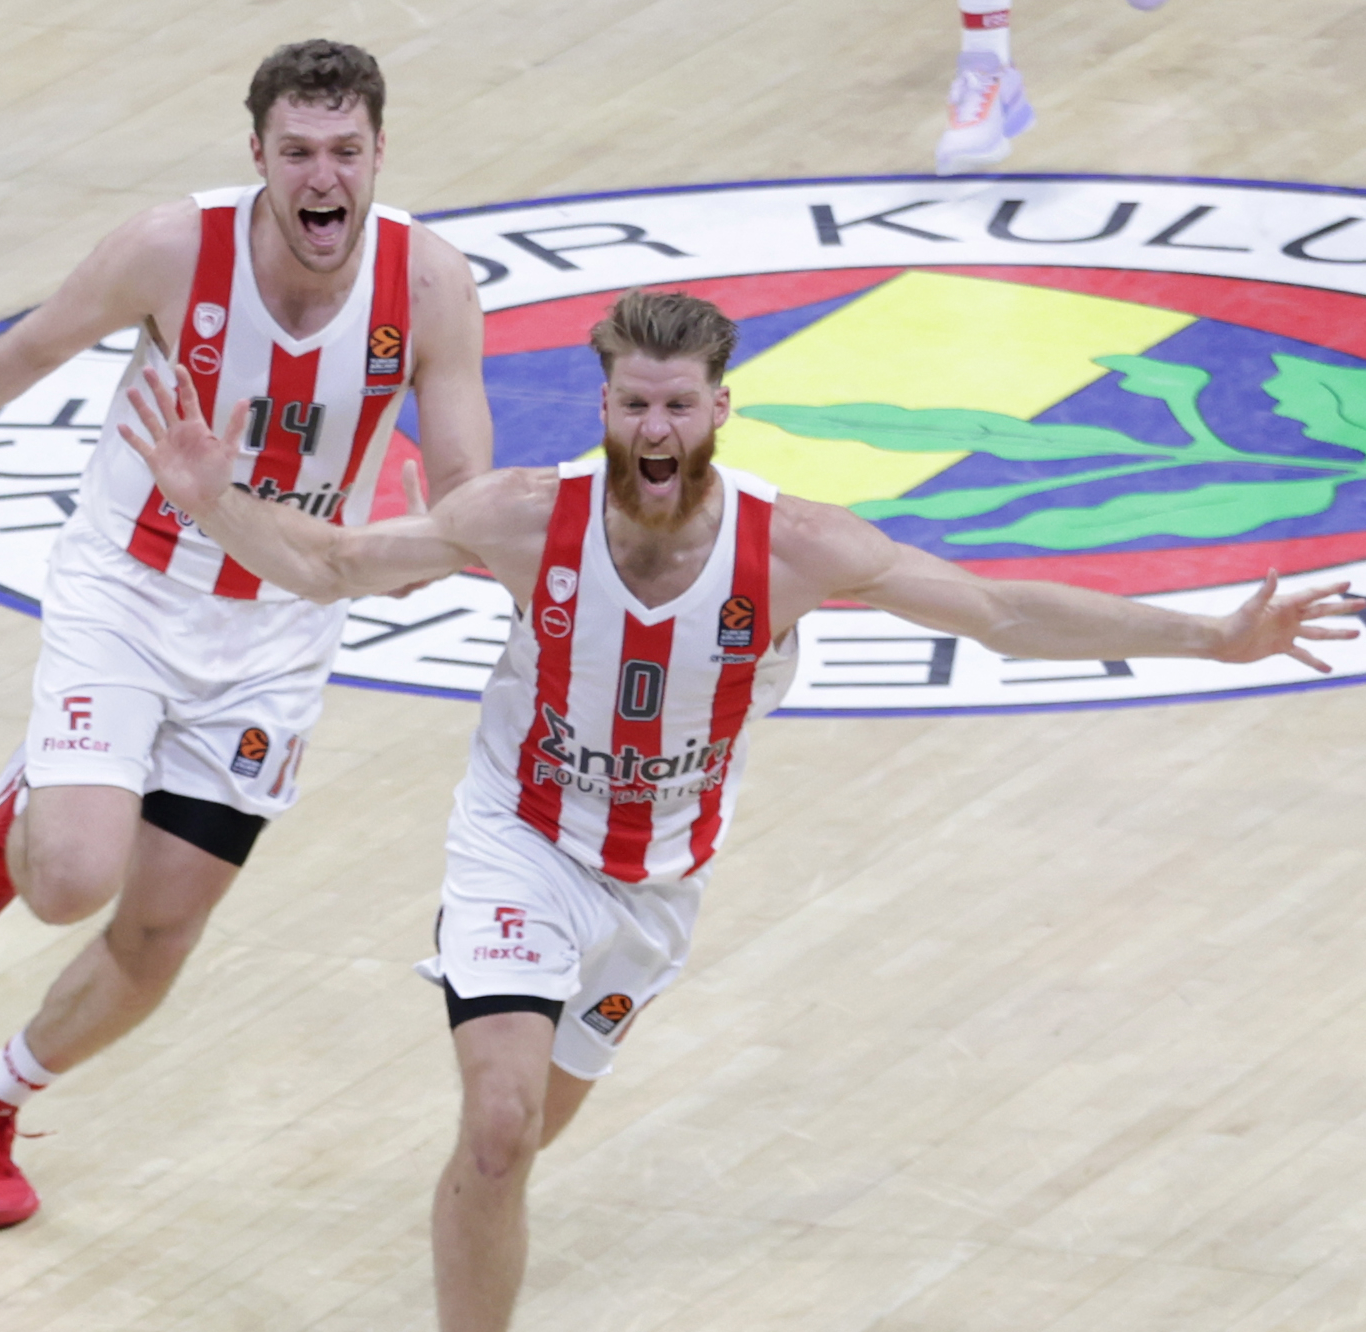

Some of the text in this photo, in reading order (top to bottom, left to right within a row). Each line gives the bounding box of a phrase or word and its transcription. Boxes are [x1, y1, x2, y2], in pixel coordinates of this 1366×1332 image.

[243, 396, 326, 456] 14
[618, 659, 665, 722] 0
[473, 946, 542, 964] FlexCar
